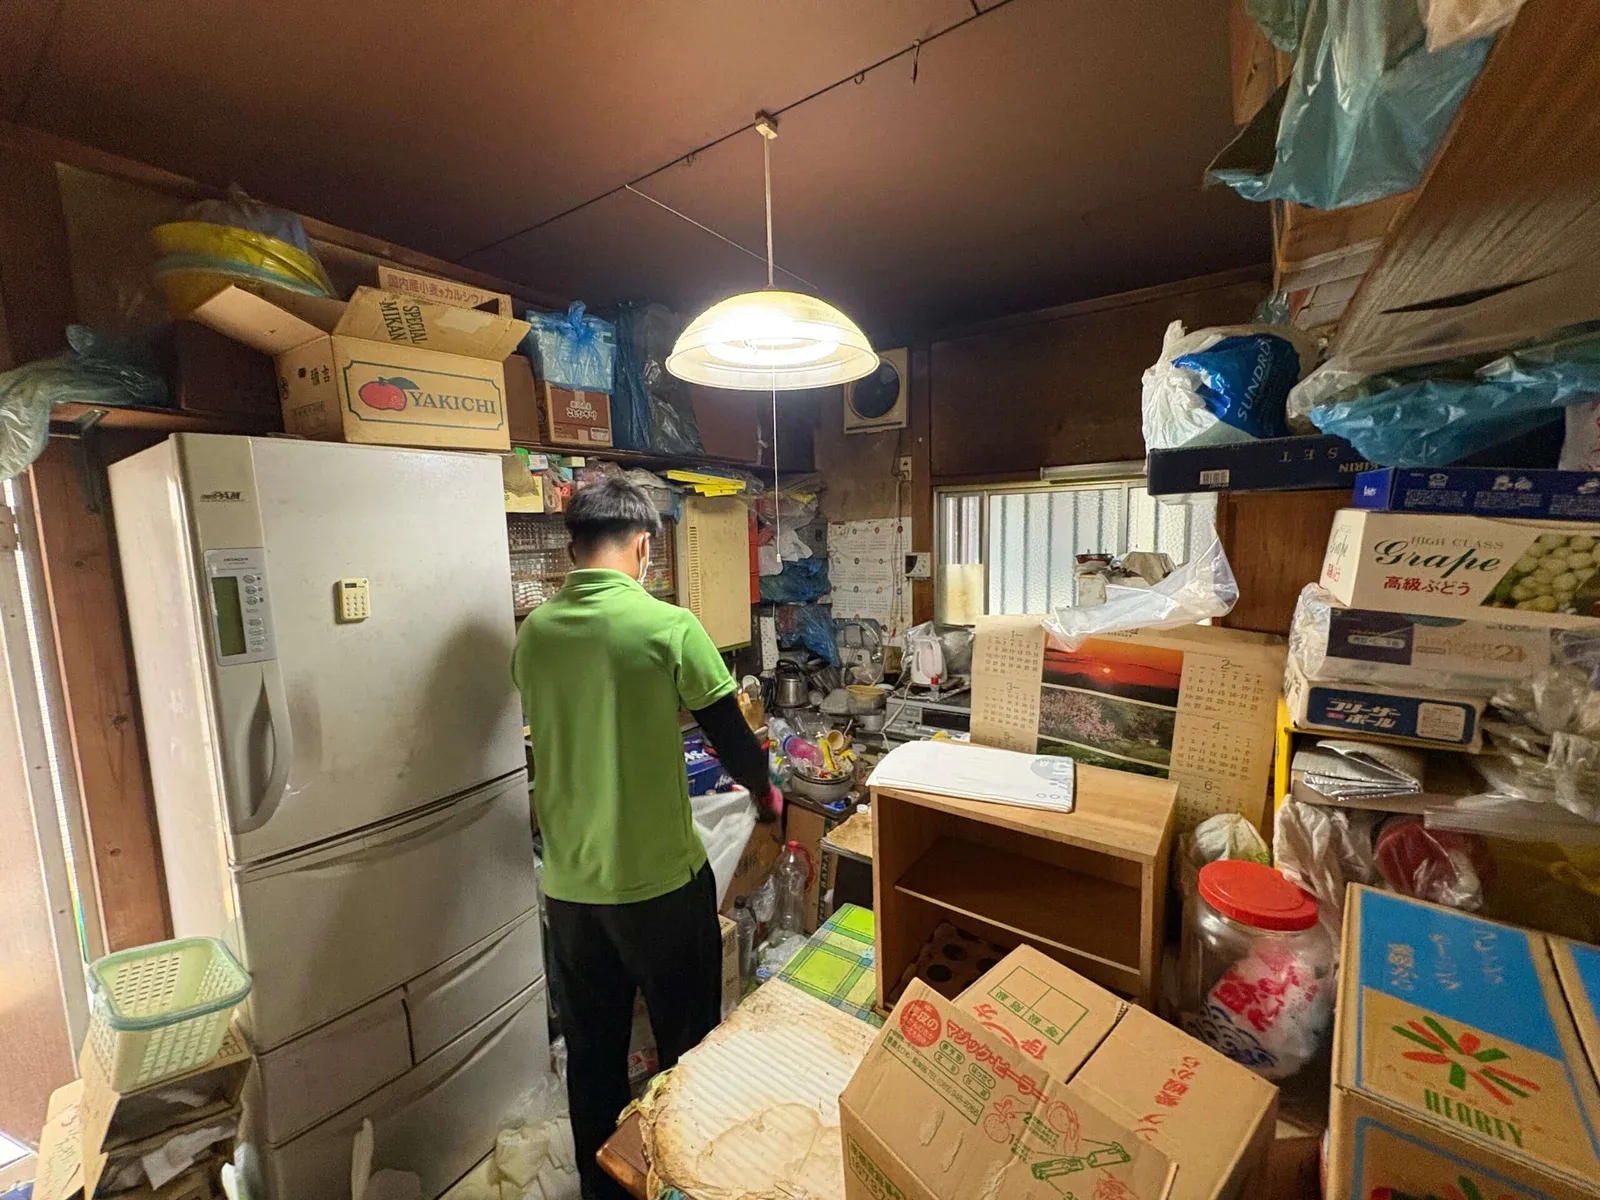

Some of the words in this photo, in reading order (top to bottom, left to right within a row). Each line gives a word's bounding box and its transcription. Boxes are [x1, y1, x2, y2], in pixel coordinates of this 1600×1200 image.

[379, 299, 408, 341] MIKAN
[403, 304, 428, 343] SPECIAL
[408, 389, 497, 416] YAKICHI
[1411, 535, 1445, 546] HIGH
[1452, 538, 1504, 549] CLASS
[1373, 538, 1502, 579] Grape
[1383, 575, 1472, 597] 高級ぶどう
[1221, 659, 1230, 670] 2
[1006, 682, 1013, 691] 3
[1212, 722, 1220, 731] 4
[1204, 781, 1212, 790] 6
